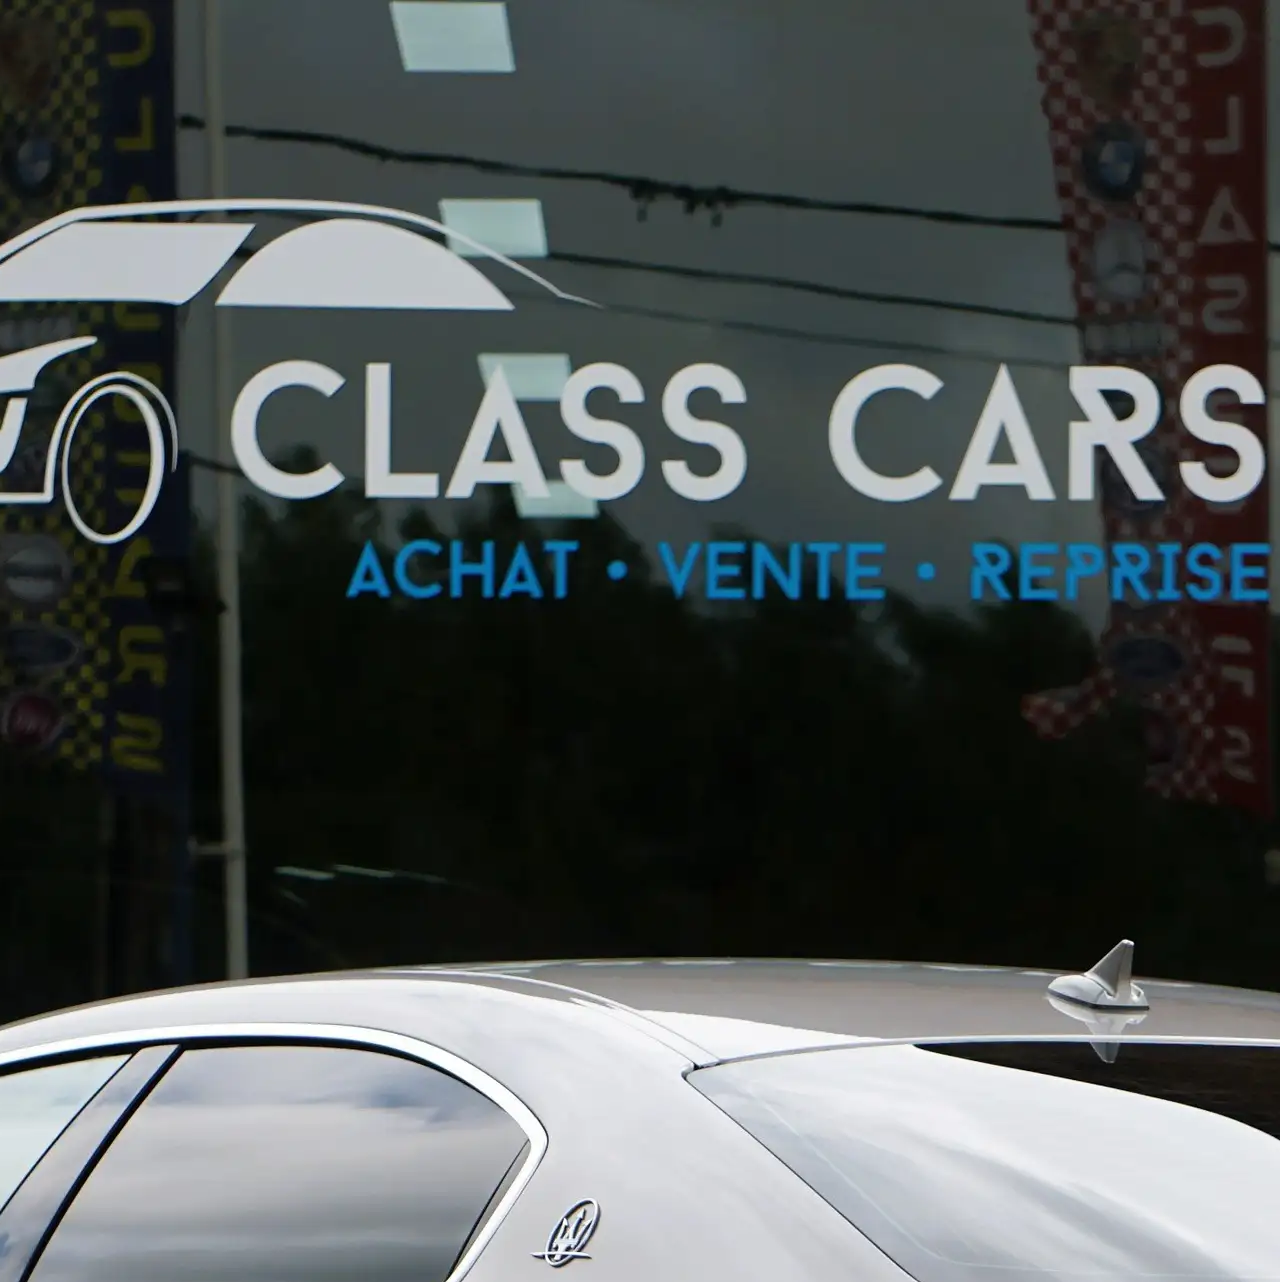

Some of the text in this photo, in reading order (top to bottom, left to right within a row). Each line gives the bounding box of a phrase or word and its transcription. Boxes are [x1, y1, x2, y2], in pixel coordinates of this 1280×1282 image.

[231, 360, 1267, 503] CLASS CARS
[346, 540, 1272, 601] ACHAT VENTE REPRISE
